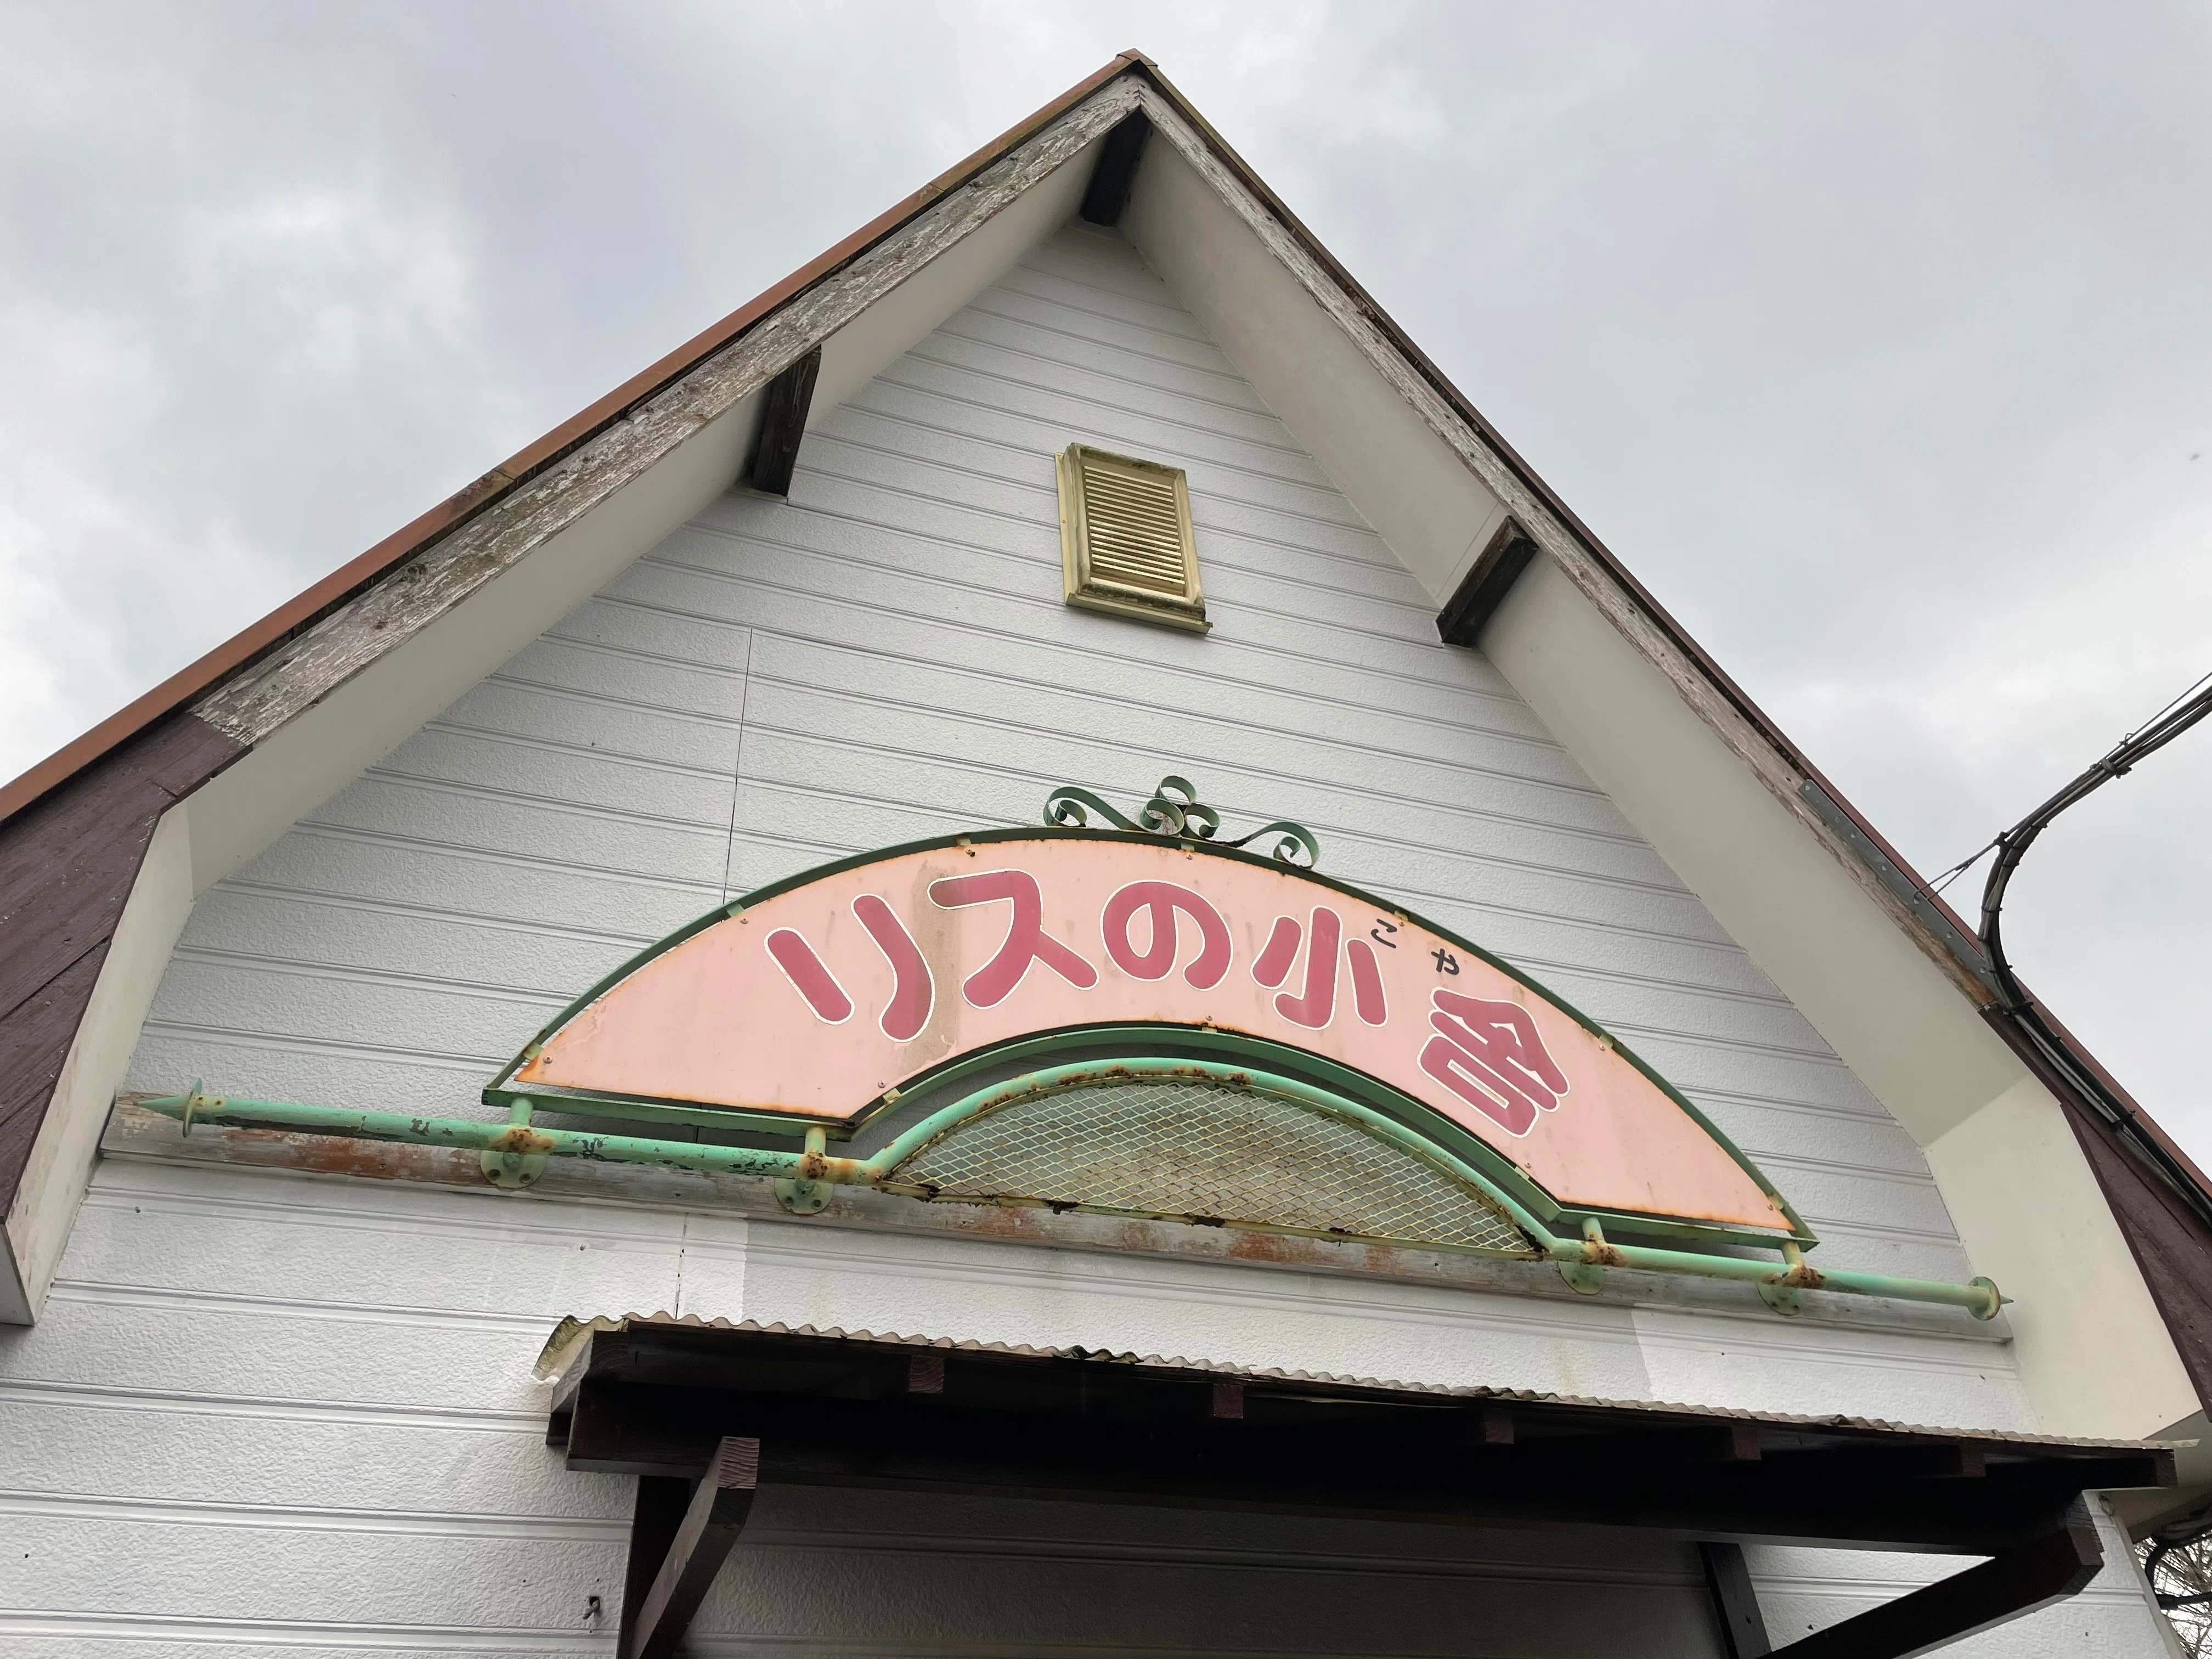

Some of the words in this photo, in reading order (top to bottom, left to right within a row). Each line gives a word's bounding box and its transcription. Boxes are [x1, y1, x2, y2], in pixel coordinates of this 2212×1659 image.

[764, 868, 1571, 1138] リスの小舎
[1370, 918, 1460, 975] こや
